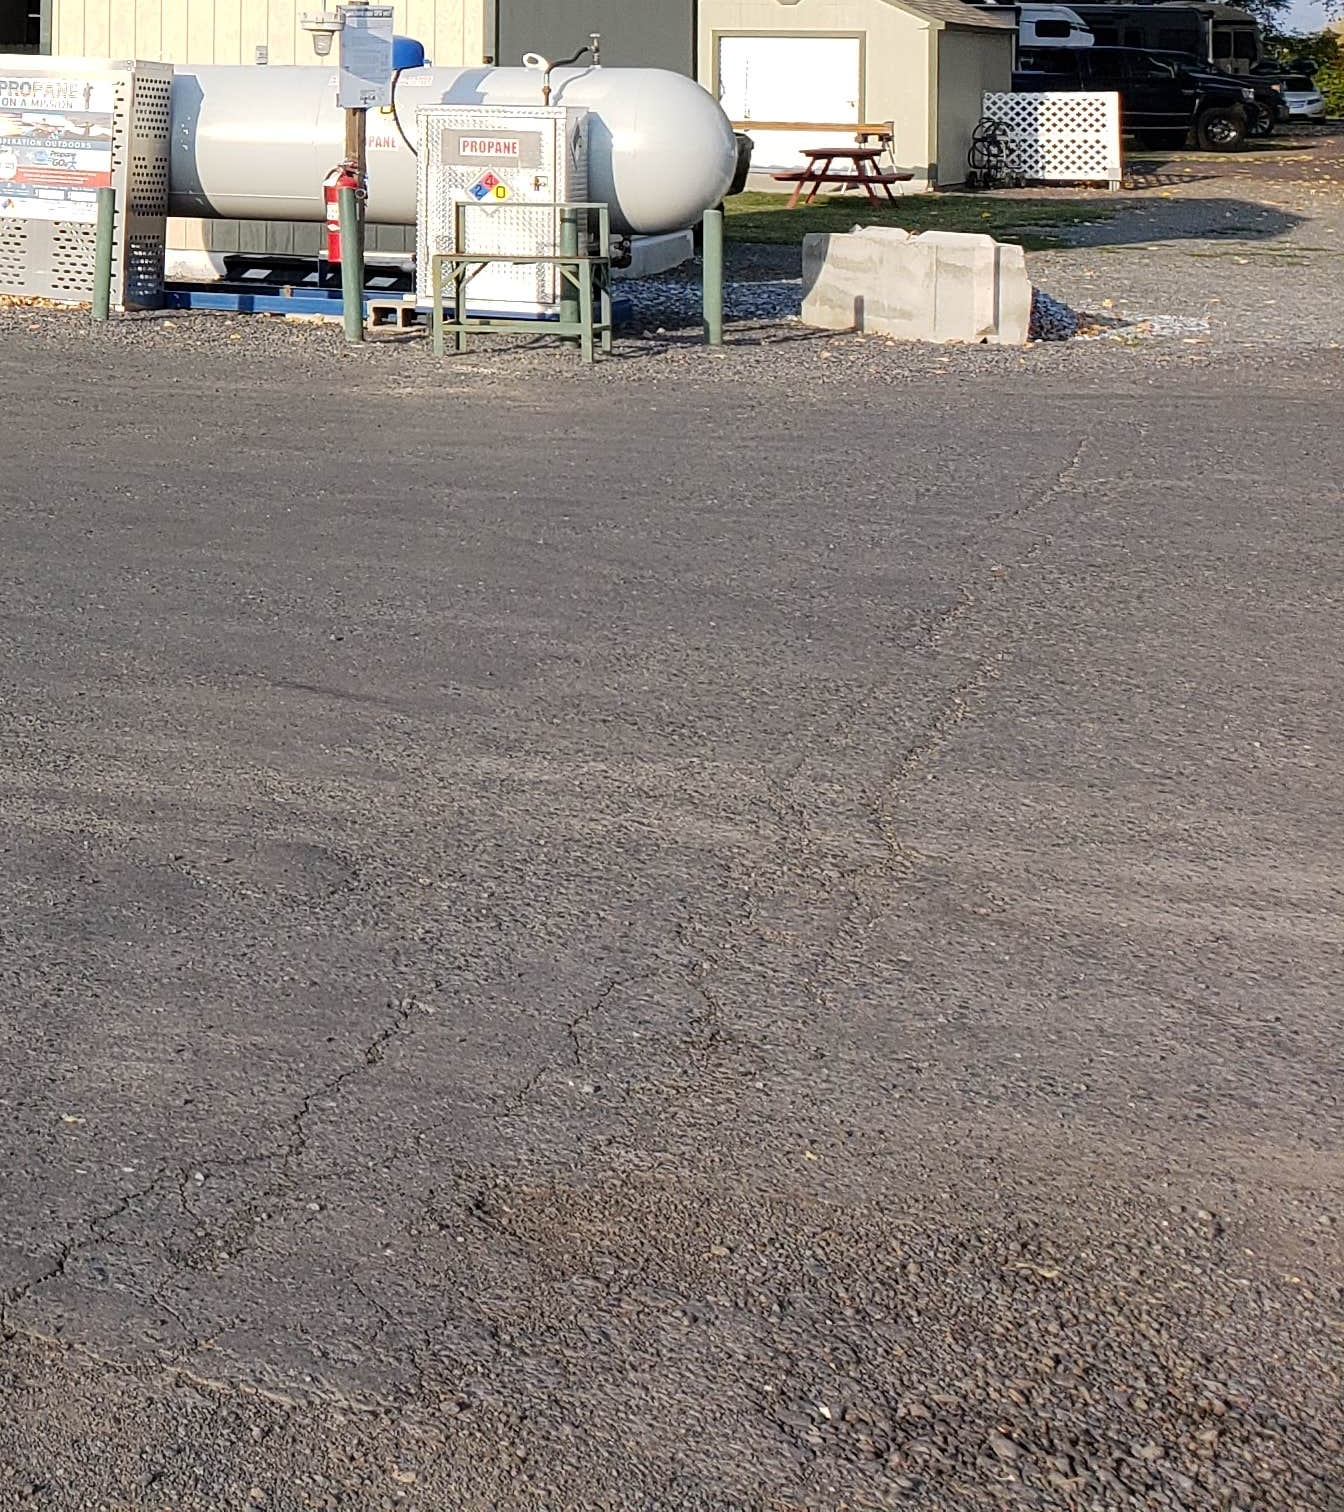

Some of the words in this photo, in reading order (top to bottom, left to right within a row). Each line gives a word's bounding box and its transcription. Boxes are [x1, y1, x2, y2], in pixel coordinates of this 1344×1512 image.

[1, 97, 17, 107] ON
[20, 98, 27, 107] A
[45, 139, 92, 149] OUTDOORS
[367, 135, 397, 149] PANE
[462, 140, 518, 155] PROPANE
[484, 174, 496, 186] 4
[474, 184, 483, 197] 2
[495, 185, 506, 199] 0
